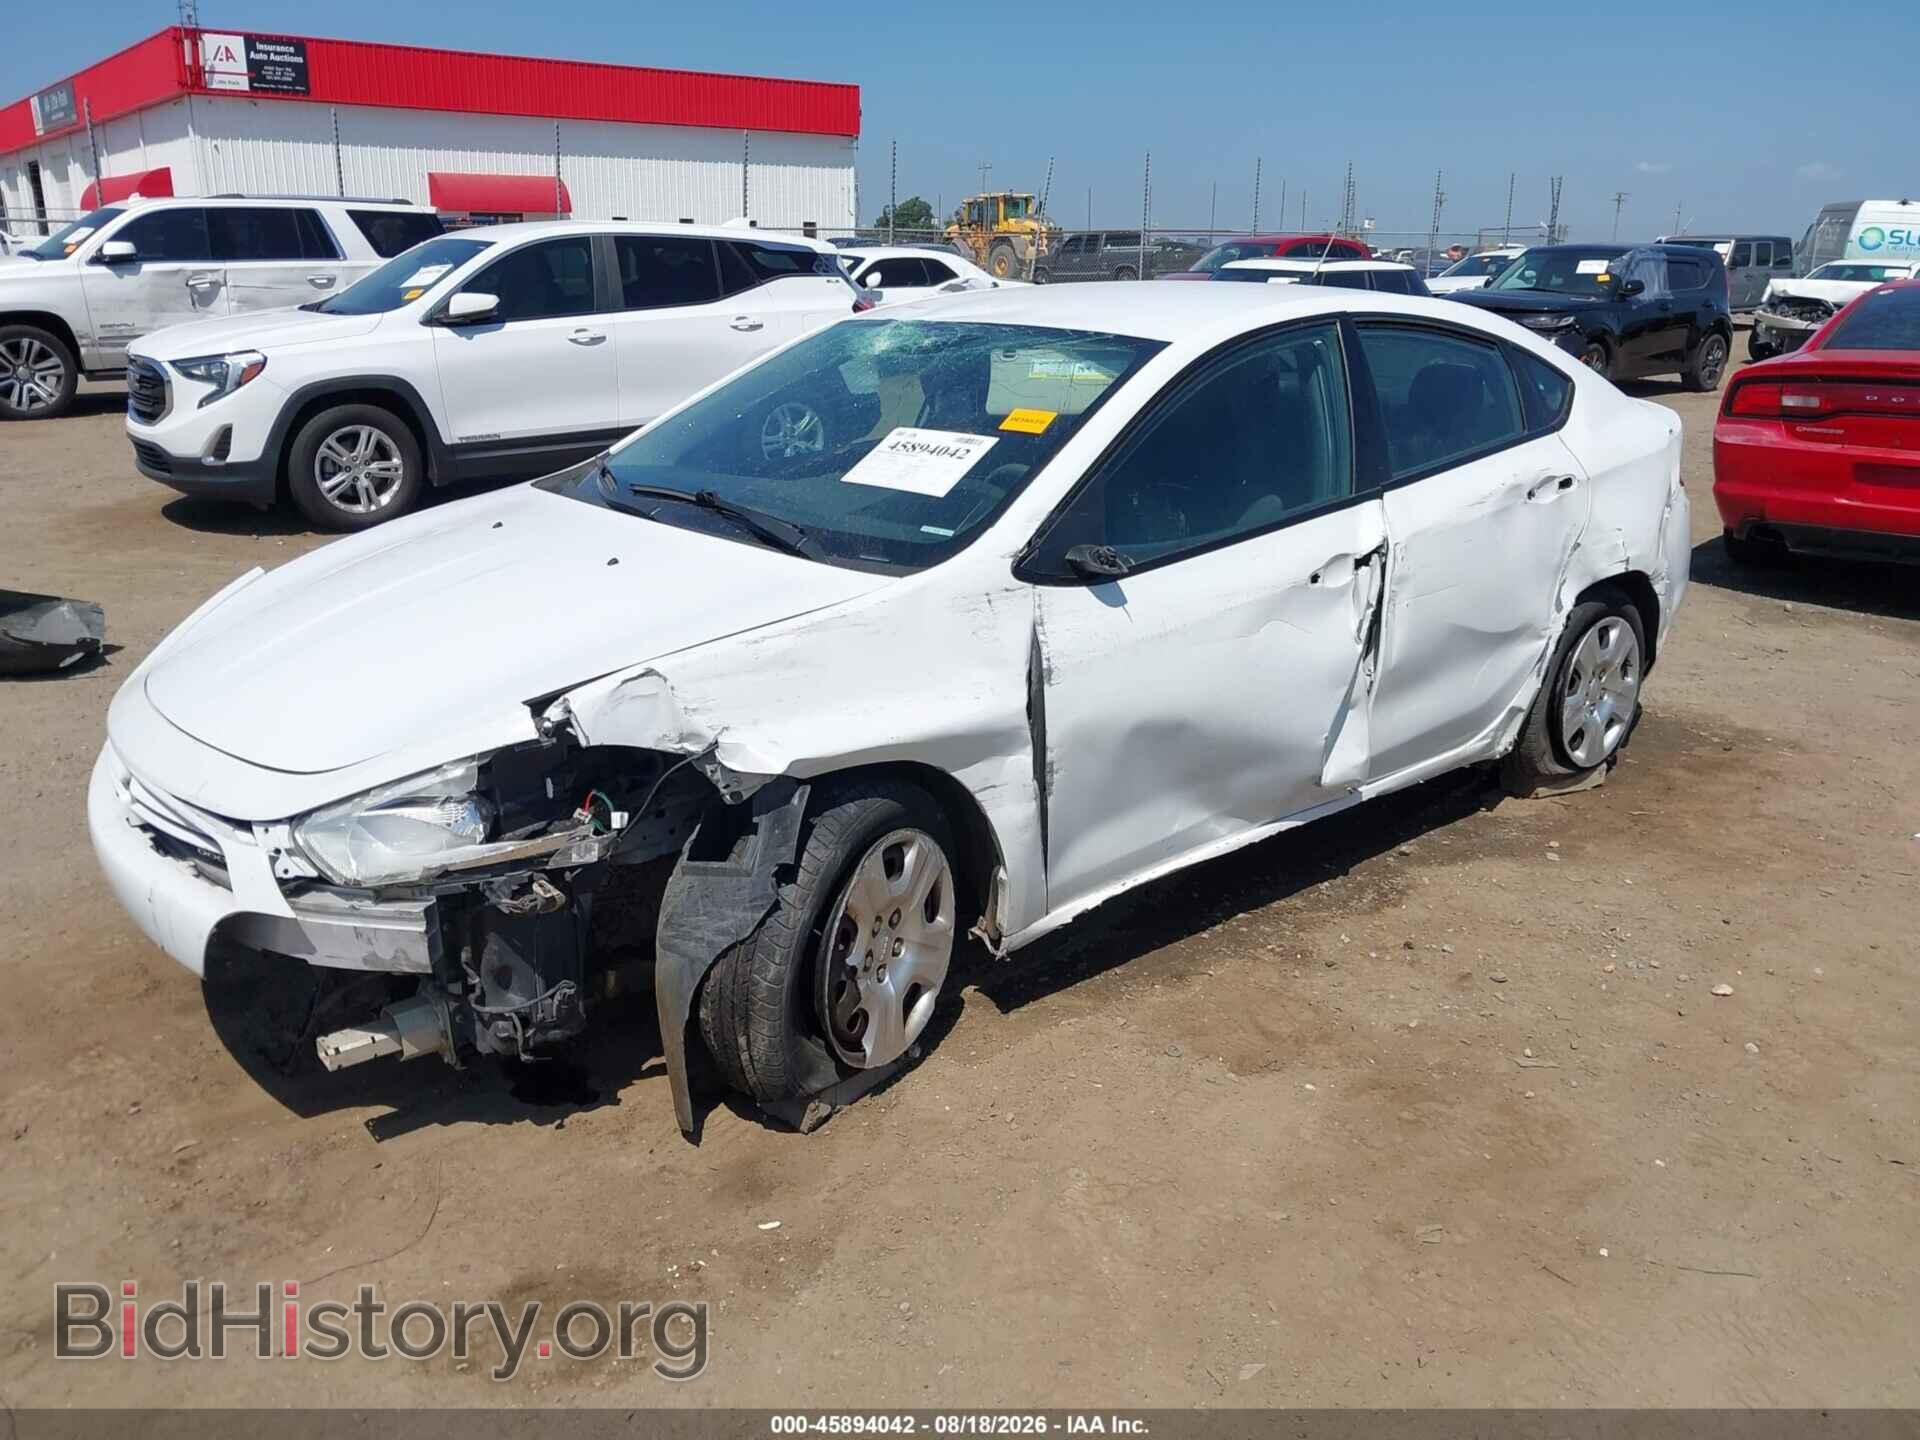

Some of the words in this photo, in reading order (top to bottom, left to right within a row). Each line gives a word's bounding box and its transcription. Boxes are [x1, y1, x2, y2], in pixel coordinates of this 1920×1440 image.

[256, 41, 294, 53] Insurance
[250, 50, 268, 60] Auto
[270, 52, 303, 63] Auctions
[1888, 229, 1920, 246] SL
[888, 440, 971, 460] 45894042
